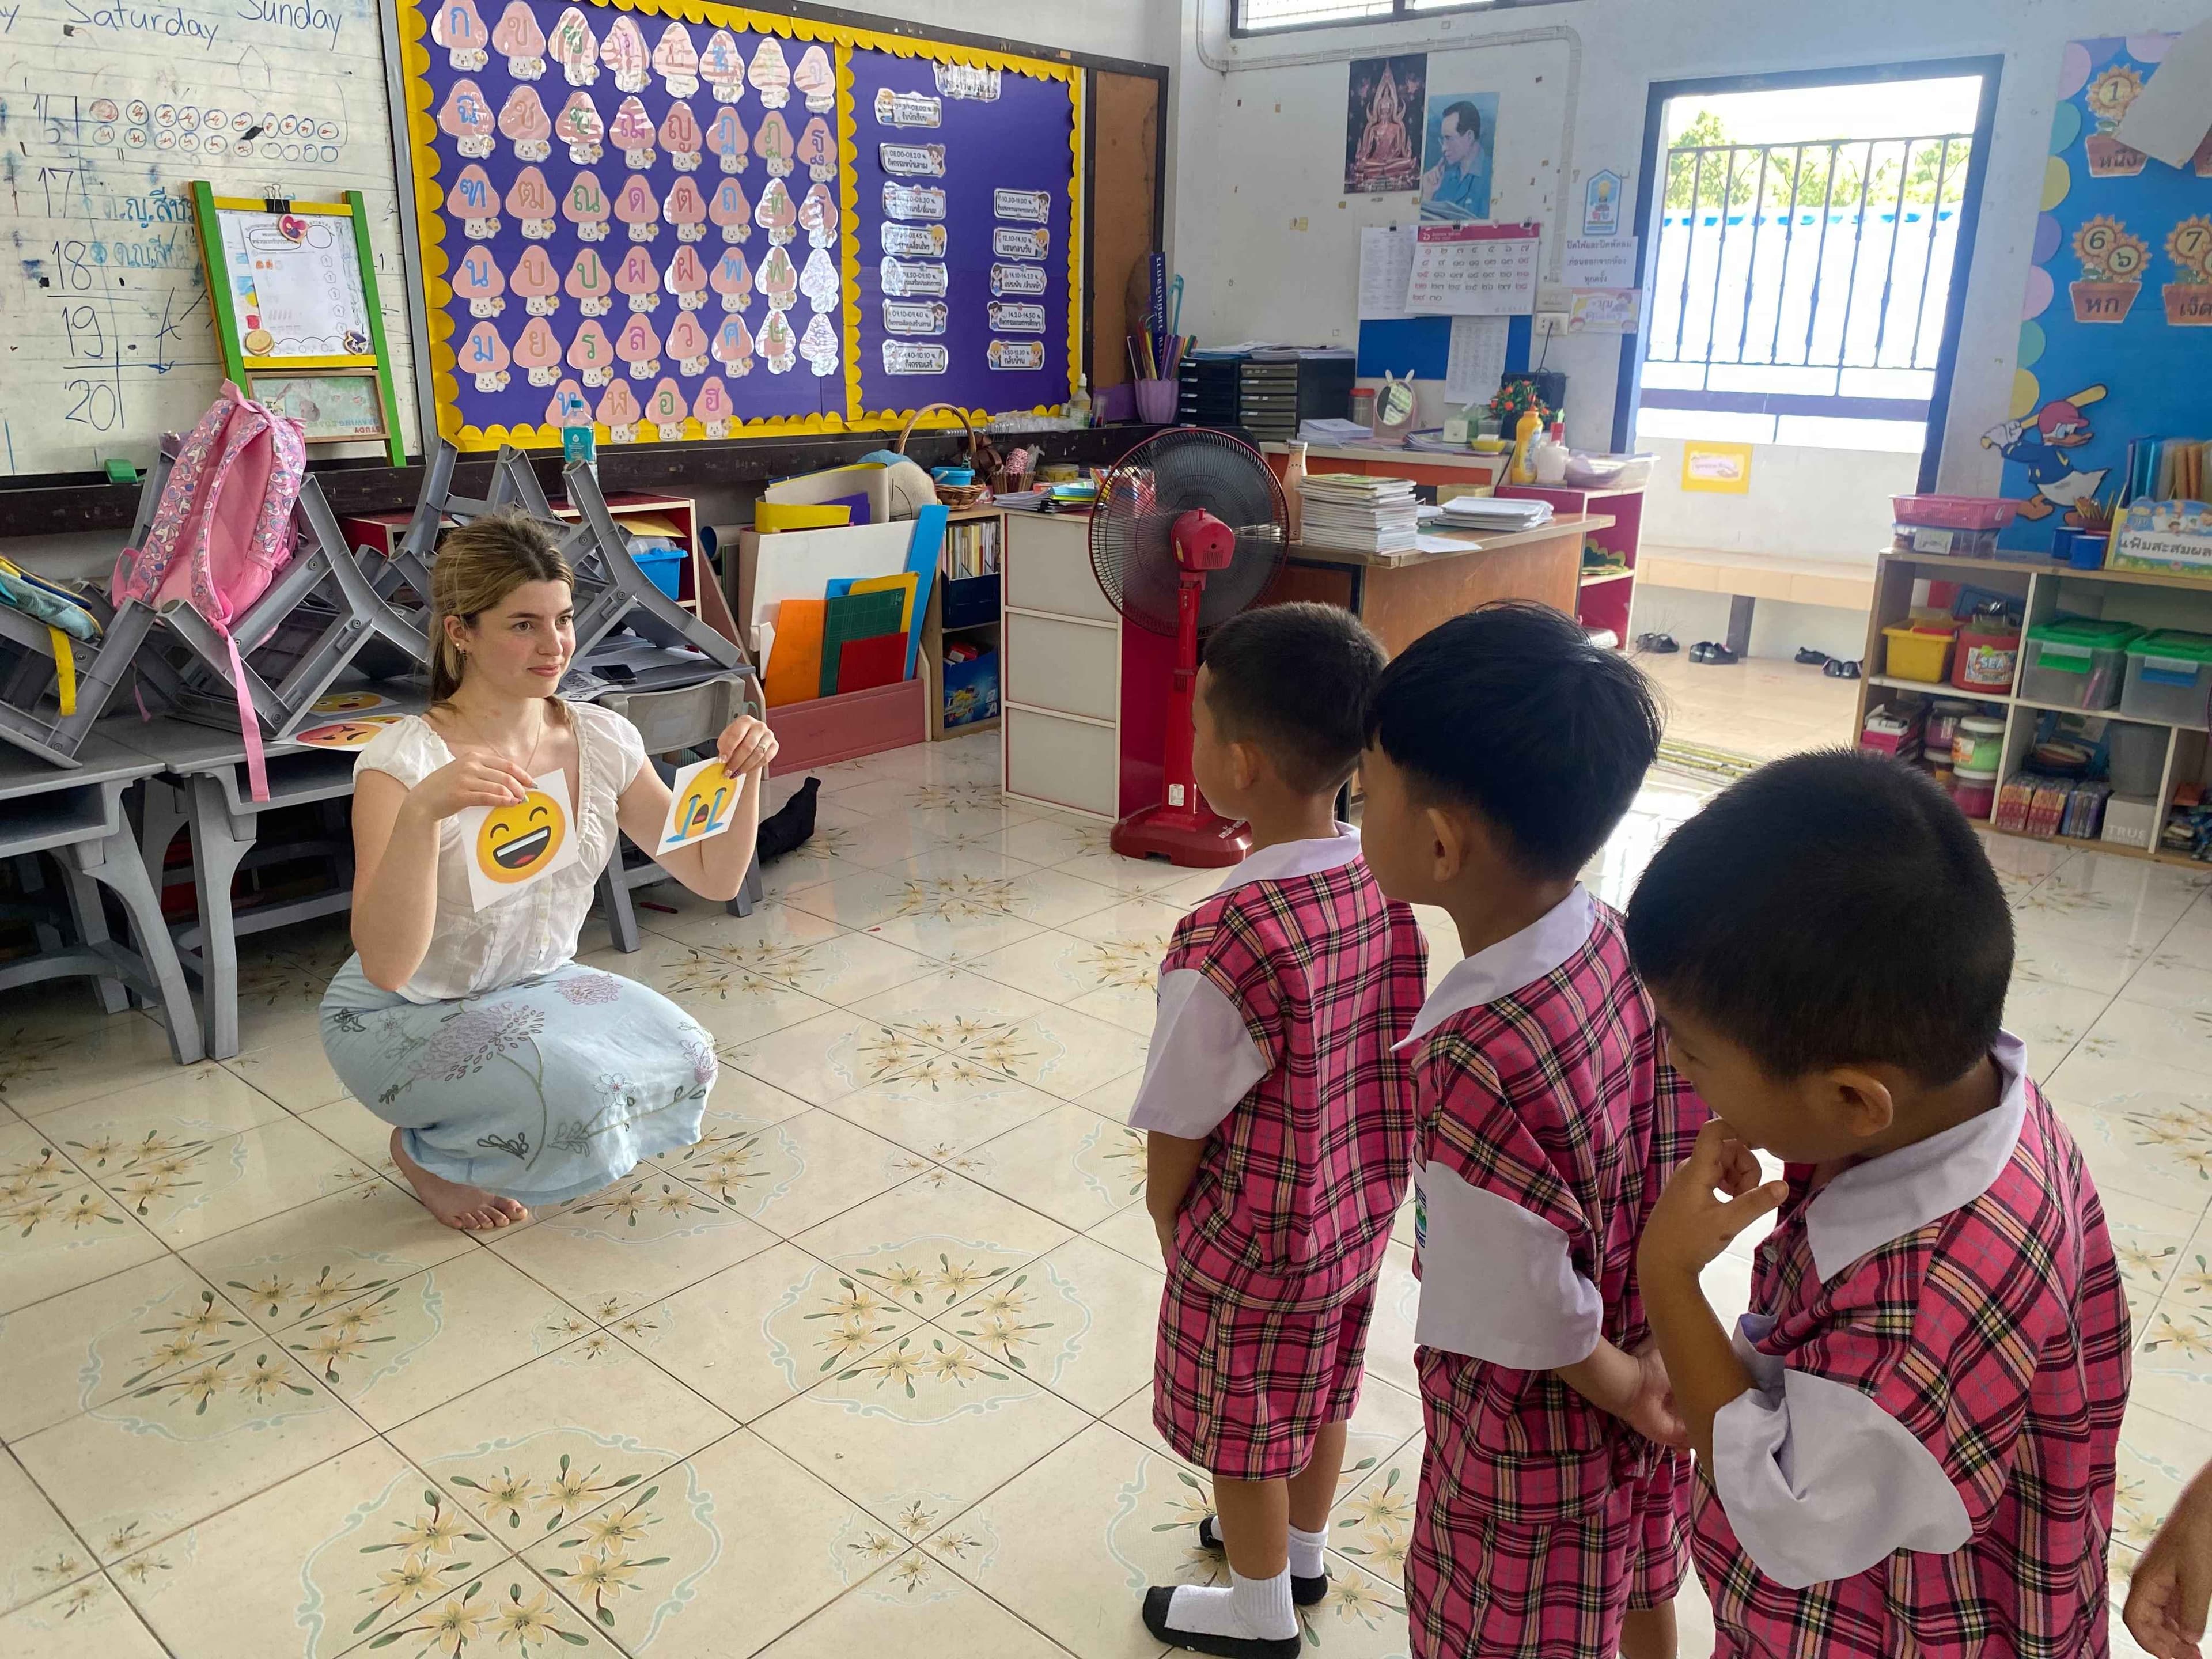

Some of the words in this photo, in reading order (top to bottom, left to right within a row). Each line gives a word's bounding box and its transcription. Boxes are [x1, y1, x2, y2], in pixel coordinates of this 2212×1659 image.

[450, 7, 471, 37] ก
[507, 17, 528, 46] ข
[2109, 81, 2120, 101] 1
[668, 115, 691, 153] ญ
[810, 129, 824, 166] ฐ
[38, 168, 73, 218] 17
[460, 179, 486, 207] ฑ
[573, 184, 600, 212] ณ
[628, 187, 645, 213] ด
[676, 187, 692, 213] ต
[722, 187, 737, 211] ถ
[2089, 230, 2106, 249] 6
[2186, 231, 2202, 252] 7
[52, 240, 91, 290] 18
[465, 260, 488, 287] น
[524, 260, 544, 286] บ
[577, 253, 597, 289] ป
[628, 258, 645, 283] ผ
[677, 248, 693, 282] ฝ
[723, 256, 741, 282] พ
[2085, 298, 2119, 313] หก
[62, 306, 104, 358] 19
[529, 331, 546, 357] ย
[629, 326, 645, 350] ล
[678, 323, 693, 347] ว
[472, 335, 493, 362] ม
[582, 334, 596, 359] ร
[65, 380, 115, 431] 20
[659, 391, 674, 415] อ
[706, 388, 720, 411] ฮ
